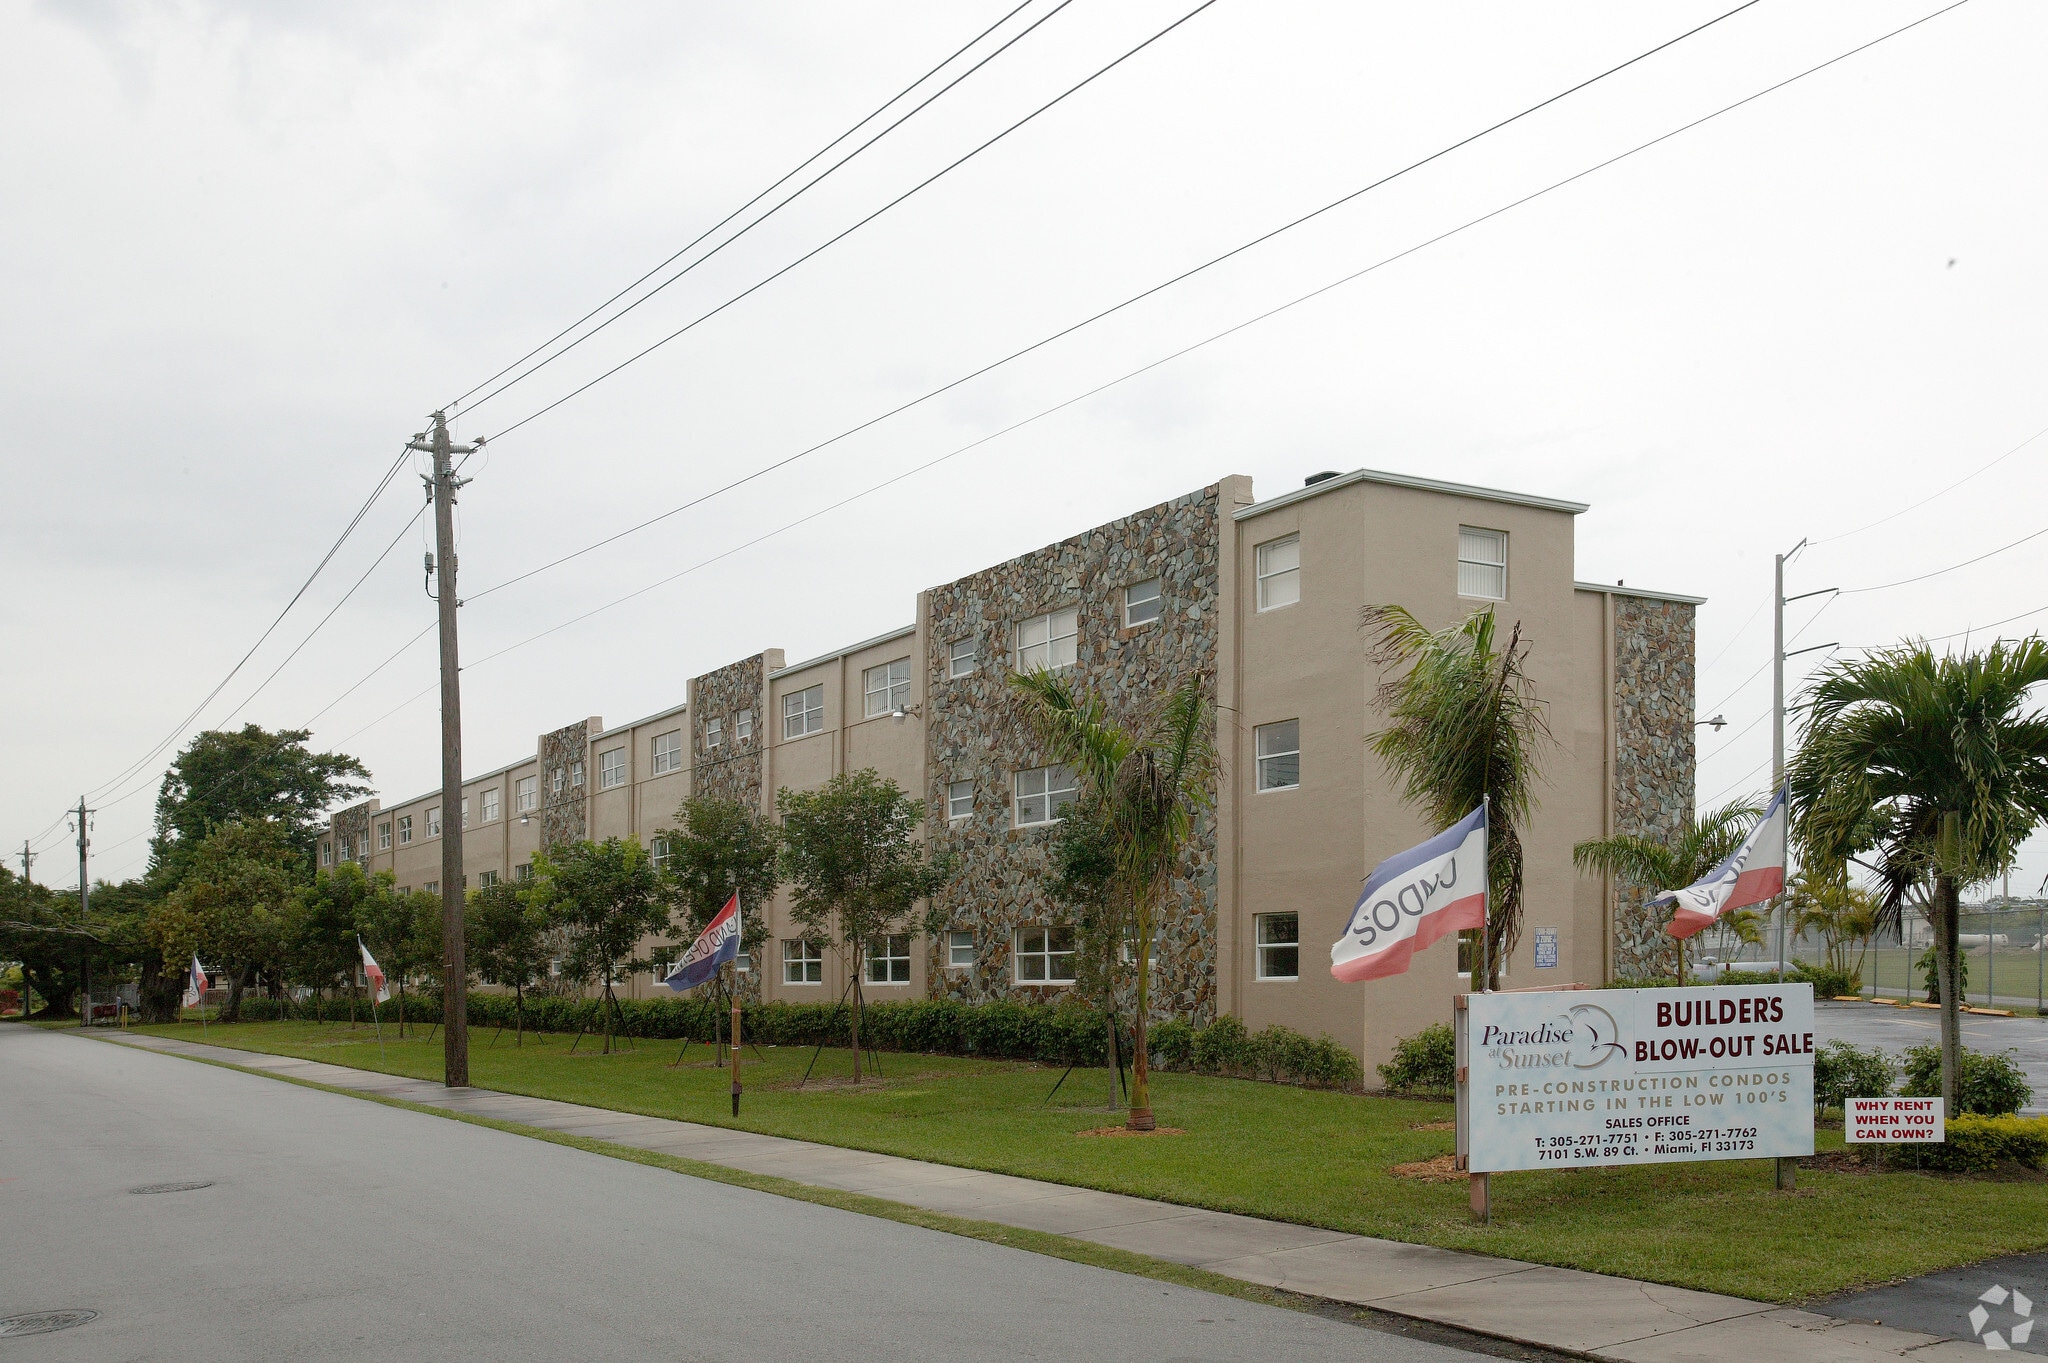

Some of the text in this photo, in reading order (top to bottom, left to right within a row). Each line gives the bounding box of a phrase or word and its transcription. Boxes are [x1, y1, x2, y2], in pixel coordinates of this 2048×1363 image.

[1656, 996, 1784, 1028] BUILDER'S
[1480, 1022, 1574, 1047] Paradise
[1498, 1047, 1573, 1070] Sunset
[1635, 1033, 1814, 1062] BLOW-OUT SALE
[1495, 1072, 1791, 1097] PRE-CONSTRUCTION CONDOS
[1497, 1090, 1788, 1116] STARTING IN THE LOW 100'S
[1855, 1101, 1934, 1111] WHY RENT
[1605, 1115, 1690, 1129] SALES OFFICE
[1855, 1115, 1935, 1125] WHEN YOU
[1535, 1127, 1758, 1148] T: 305-271-7751 F: 305-271-7762
[1855, 1129, 1934, 1139] CAN OWN?
[1538, 1149, 1569, 1161] 7101
[1574, 1147, 1600, 1159] S.W.
[1603, 1146, 1620, 1157] 89
[1623, 1145, 1640, 1156] Ct.
[1654, 1143, 1697, 1155] Miami,
[1715, 1139, 1755, 1152] 33173
